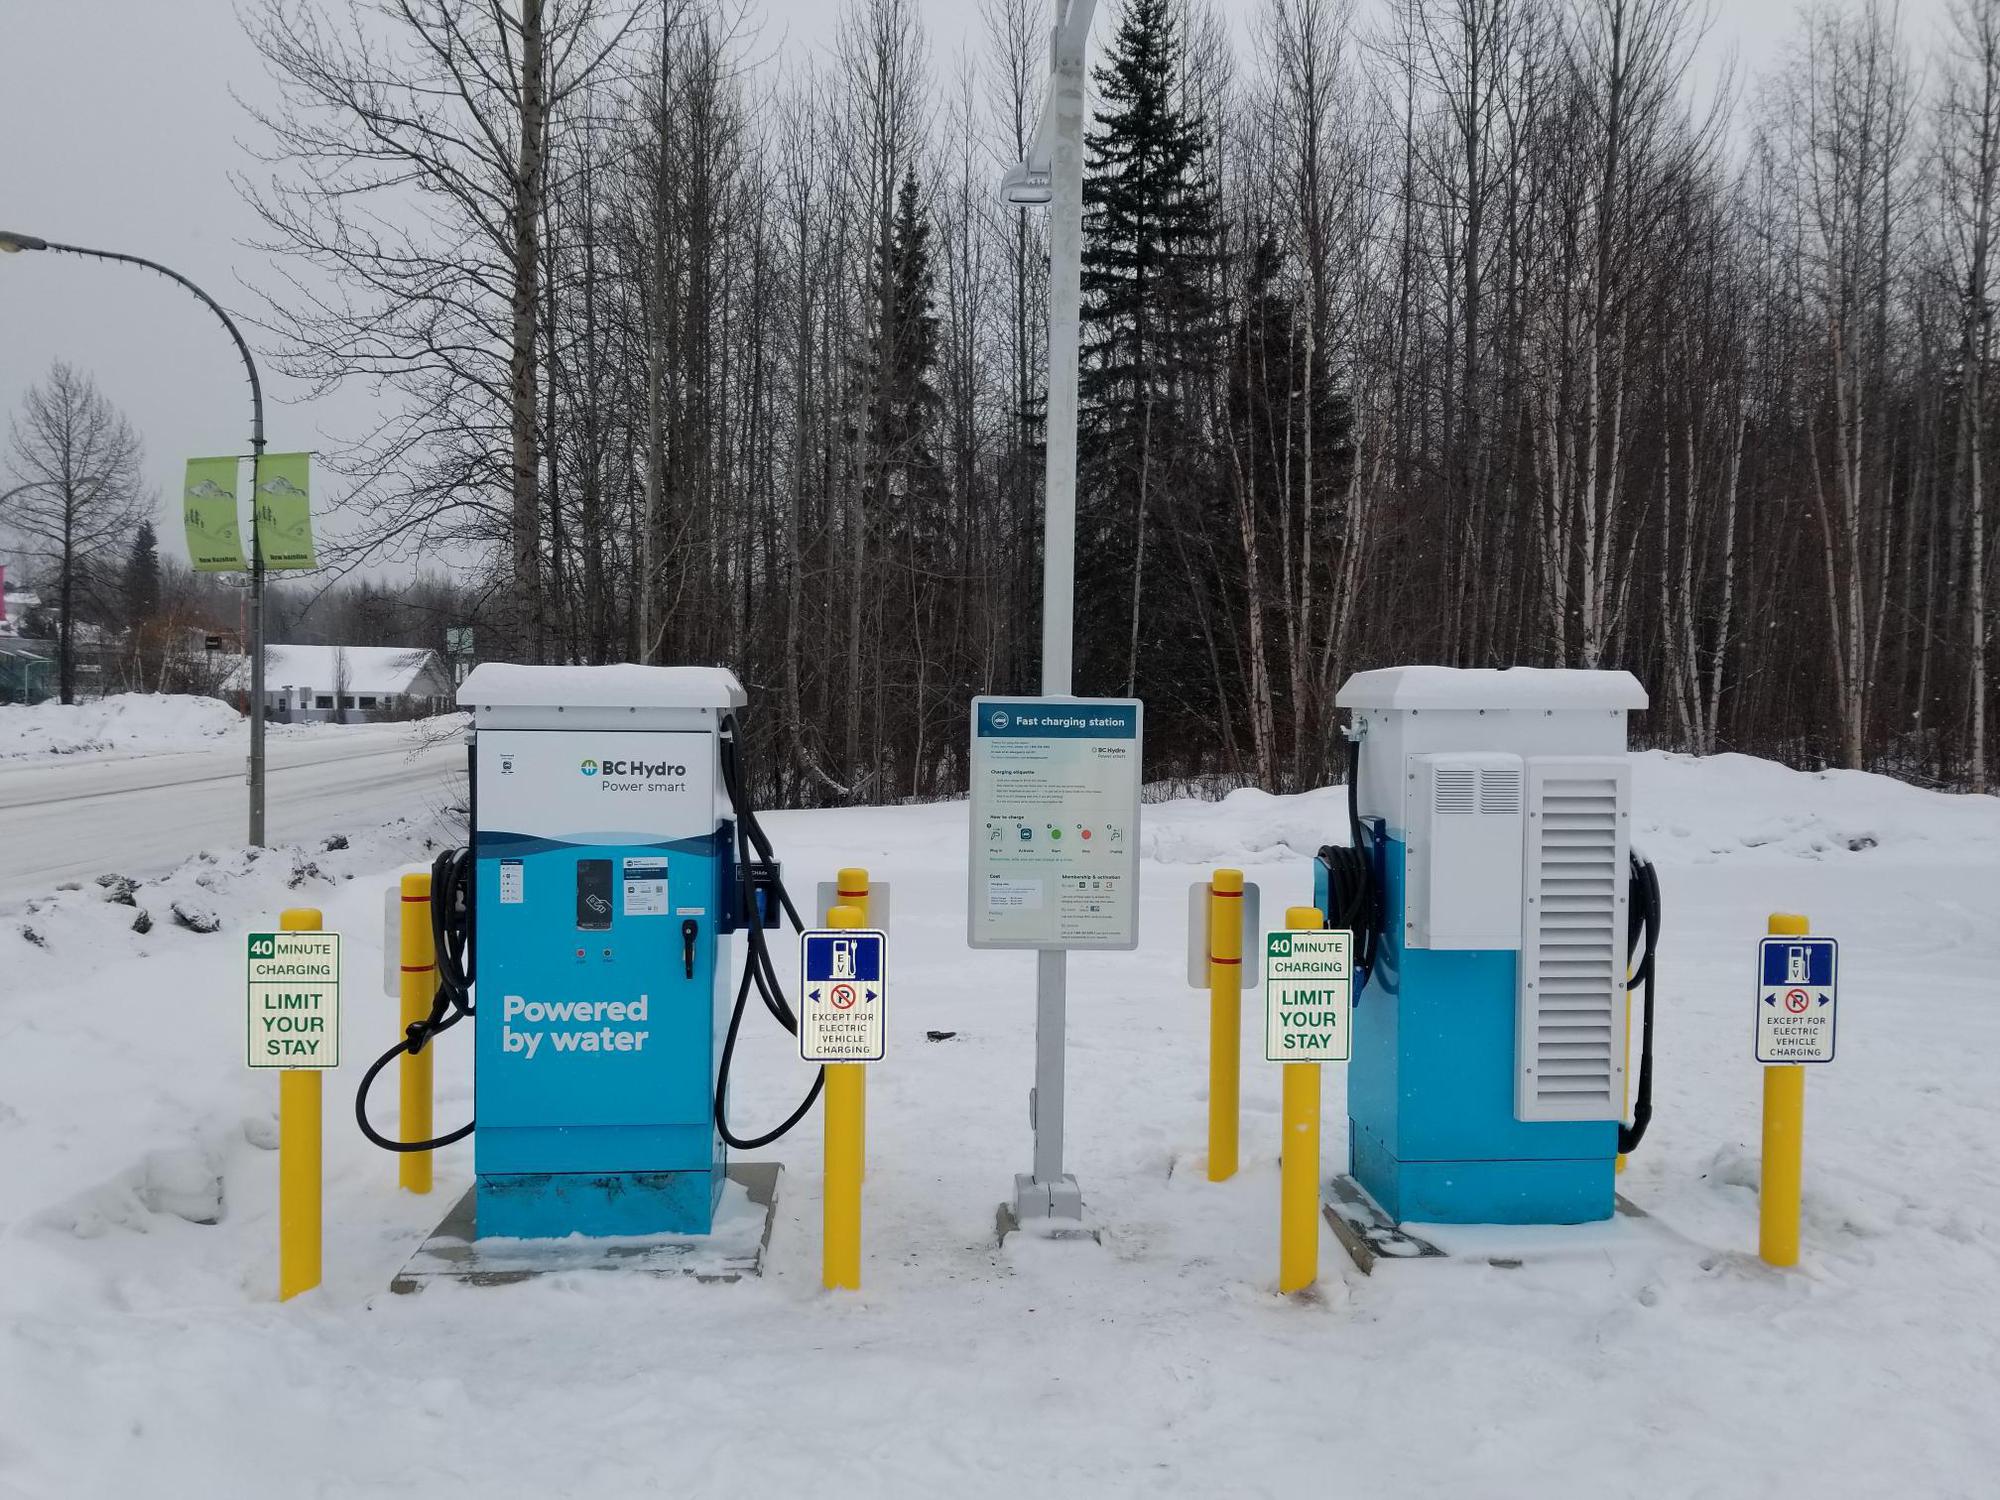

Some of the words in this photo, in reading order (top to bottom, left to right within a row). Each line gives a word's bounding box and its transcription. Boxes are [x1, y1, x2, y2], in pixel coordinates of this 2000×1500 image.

[1016, 716, 1038, 726] Fast
[1041, 716, 1086, 728] charging
[1089, 717, 1125, 727] station
[602, 761, 627, 776] BC
[630, 761, 686, 779] Hydro
[602, 781, 643, 792] Power
[648, 782, 686, 792] smart
[250, 940, 273, 955] 40
[277, 944, 331, 955] MINUTE
[1270, 939, 1290, 953] 40
[1294, 942, 1343, 953] MINUTE
[256, 964, 330, 975] CHARGING
[1274, 962, 1342, 972] CHARGING
[265, 993, 323, 1010] LIMIT
[1282, 990, 1335, 1005] LIMIT
[503, 994, 648, 1022] Powered
[812, 1013, 851, 1021] EXCEPT
[854, 1013, 874, 1021] FOR
[1279, 1012, 1336, 1027] YOUR
[1767, 1017, 1803, 1025] EXCEPT
[1807, 1017, 1826, 1025] FOR
[262, 1017, 324, 1032] YOUR
[819, 1024, 867, 1032] ELECTRIC
[503, 1026, 544, 1059] by
[550, 1027, 649, 1052] water
[822, 1035, 865, 1043] VEHICLE
[1283, 1034, 1332, 1049] STAY
[1776, 1038, 1816, 1046] VEHICLE
[267, 1040, 320, 1056] STAY
[816, 1046, 870, 1054] CHARGING
